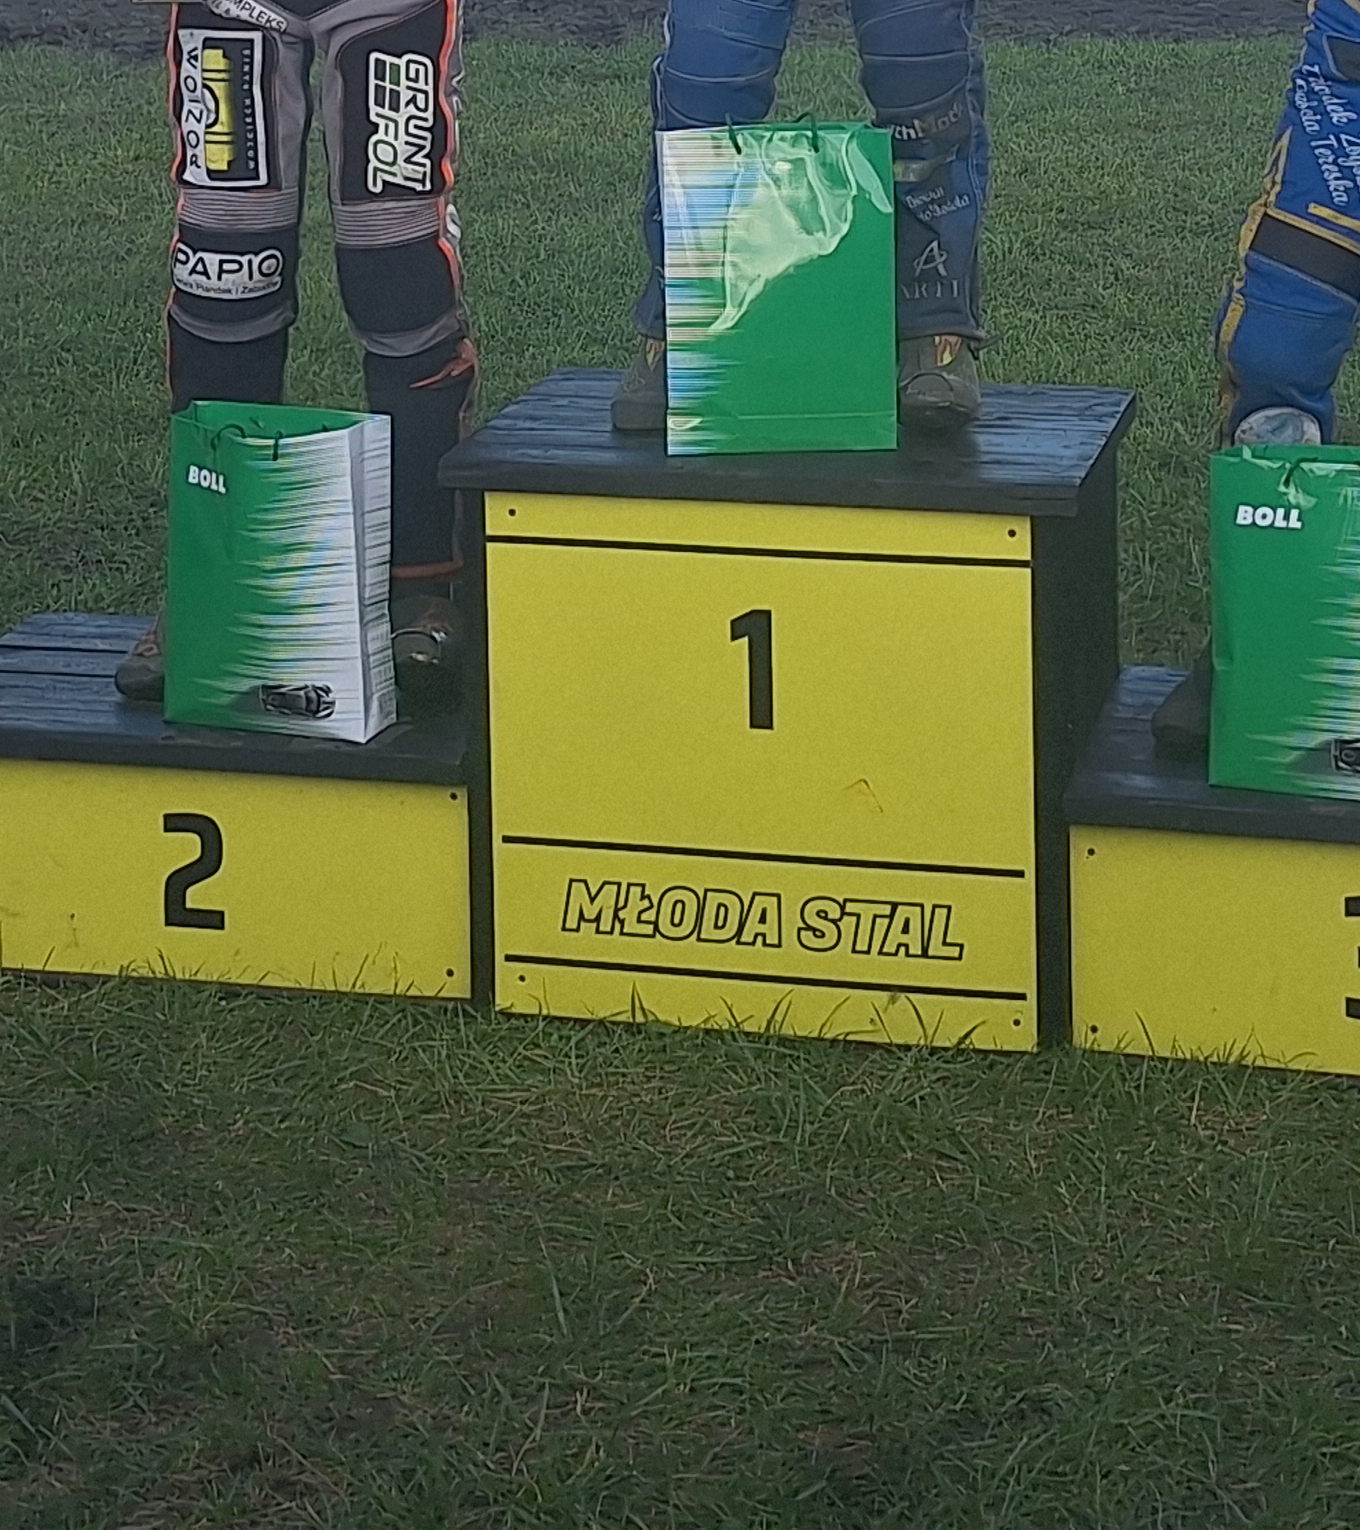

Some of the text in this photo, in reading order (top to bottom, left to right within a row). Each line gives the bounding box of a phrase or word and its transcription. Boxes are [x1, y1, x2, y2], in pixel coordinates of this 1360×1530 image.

[372, 112, 399, 189] FOL
[403, 58, 430, 189] GRUNT
[1310, 134, 1355, 207] Tereska
[173, 246, 281, 282] PAPIO
[187, 465, 227, 495] BOLL
[1235, 504, 1303, 530] BOLL
[729, 608, 775, 730] 1
[162, 812, 226, 931] 2
[561, 877, 964, 961] MŁODA STAL
